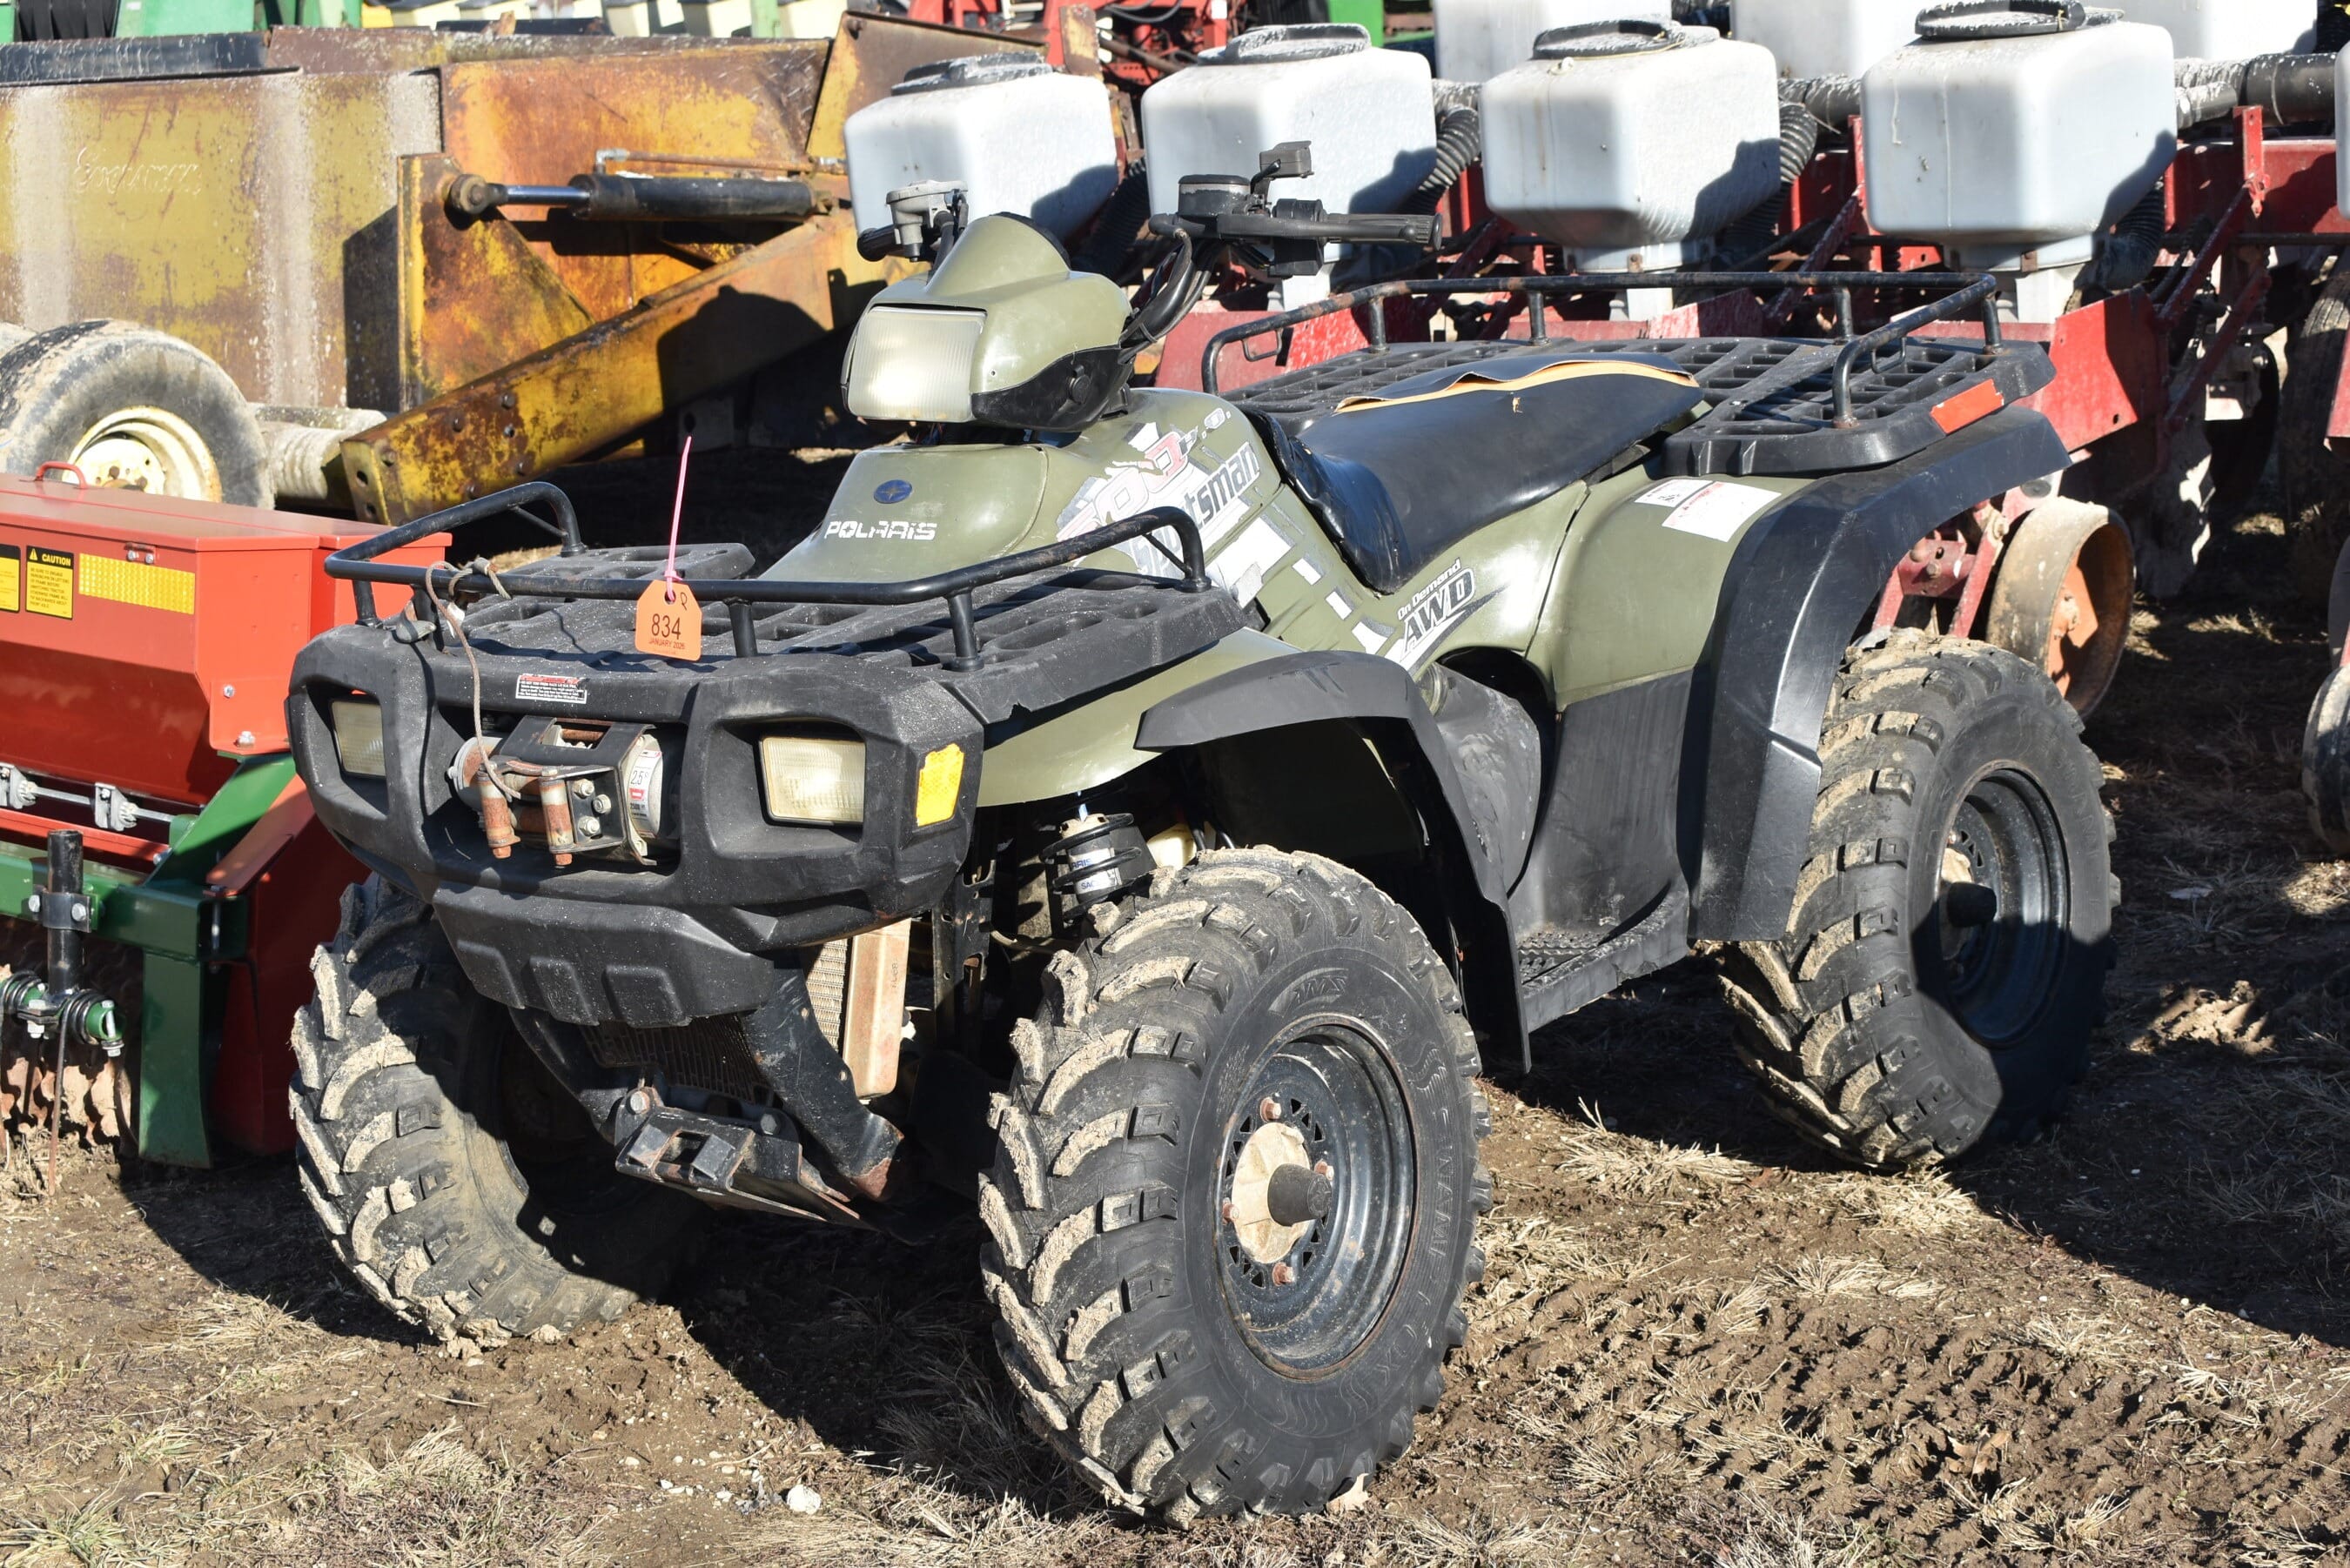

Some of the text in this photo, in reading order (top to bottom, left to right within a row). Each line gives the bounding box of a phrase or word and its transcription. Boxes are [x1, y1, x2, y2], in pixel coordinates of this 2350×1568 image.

[823, 520, 937, 540] POLARIS
[42, 553, 71, 566] CAUTION
[1397, 557, 1461, 620] On Demand
[1403, 567, 1475, 654] AWD
[651, 613, 682, 640] 834
